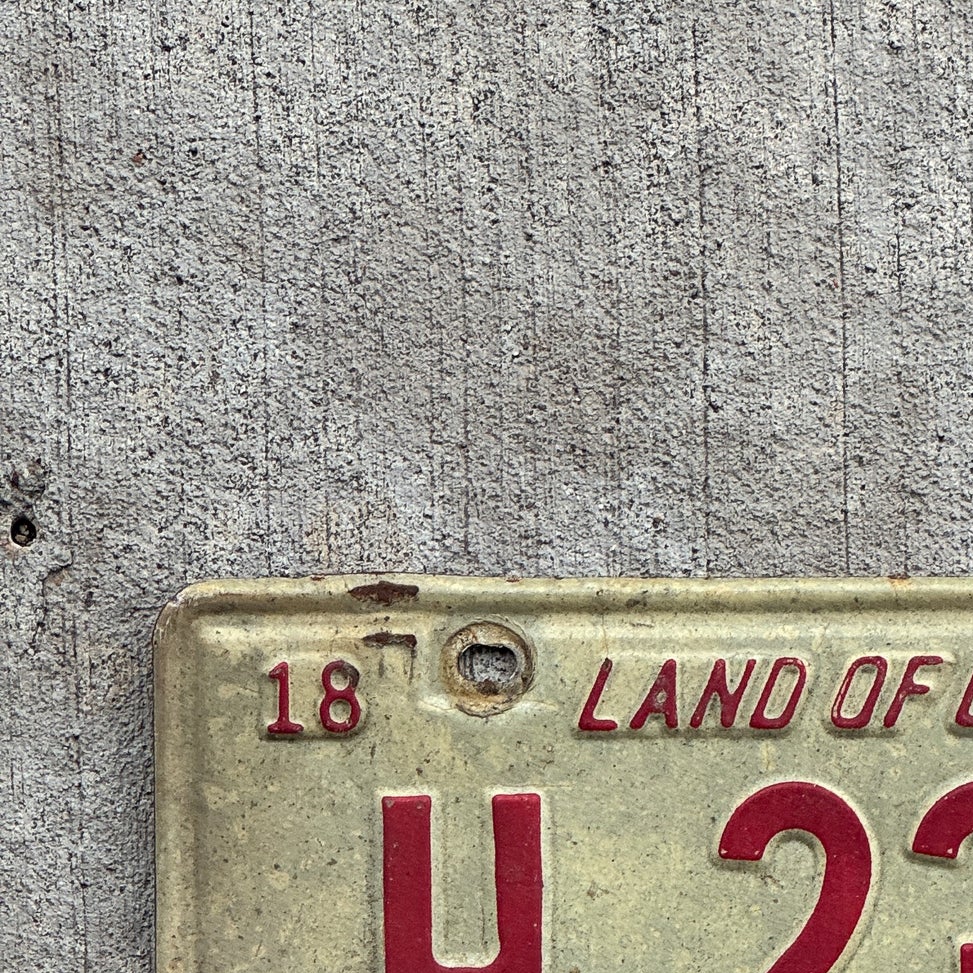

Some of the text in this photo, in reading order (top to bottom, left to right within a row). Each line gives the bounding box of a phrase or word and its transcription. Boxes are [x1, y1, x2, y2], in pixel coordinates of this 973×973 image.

[266, 659, 361, 735] 18
[578, 656, 807, 731] LAND
[830, 655, 942, 729] OF
